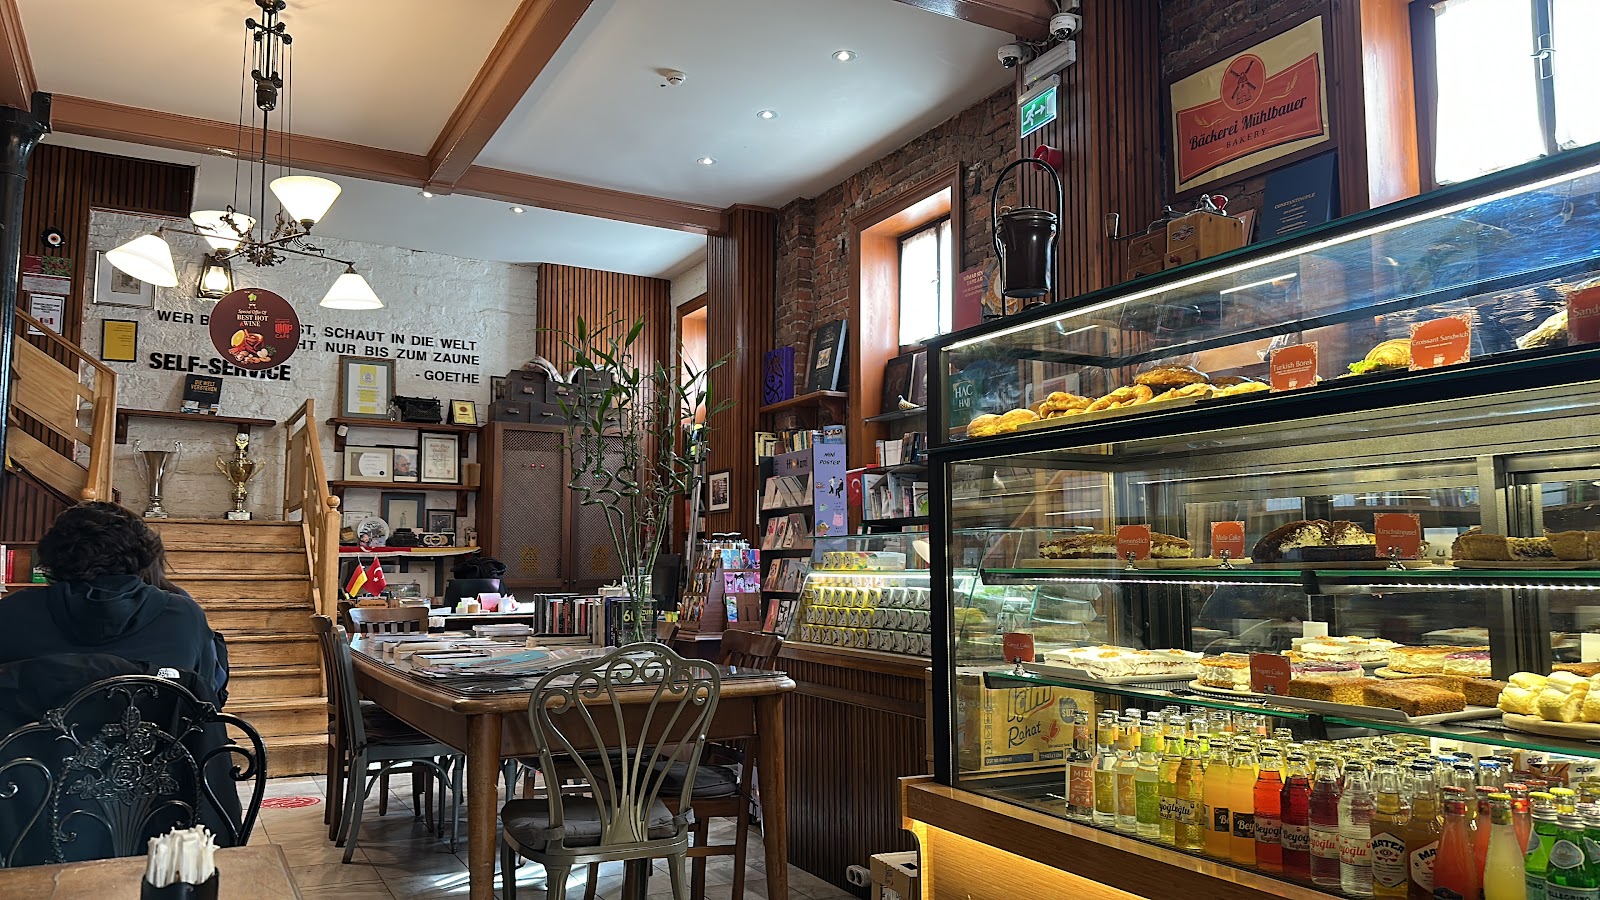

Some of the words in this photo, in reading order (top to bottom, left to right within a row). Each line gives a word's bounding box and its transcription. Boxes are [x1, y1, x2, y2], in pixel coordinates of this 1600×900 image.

[1190, 120, 1239, 151] Bäckerei
[1241, 96, 1308, 131] Mühlbauer
[1226, 127, 1267, 149] BAKERY
[157, 309, 194, 324] WER
[1573, 304, 1600, 317] Sand
[254, 314, 269, 322] HOT
[300, 324, 317, 338] ST,
[324, 326, 386, 343] SCHAUT
[391, 333, 405, 344] IN
[411, 335, 434, 348] DIE
[440, 338, 477, 352] WELT
[1411, 336, 1439, 347] Croissant
[1439, 331, 1469, 341] Sandwich
[325, 341, 357, 355] NUR
[365, 345, 389, 358] BIS
[396, 348, 427, 362] ZUM
[433, 352, 480, 366] ZAUNE
[1273, 361, 1295, 372] Turkish
[424, 370, 480, 384] GOETHE
[1008, 721, 1042, 749] Rahat
[1073, 769, 1093, 777] MIZU
[1098, 775, 1114, 783] MIZ
[1137, 785, 1159, 794] MIZU
